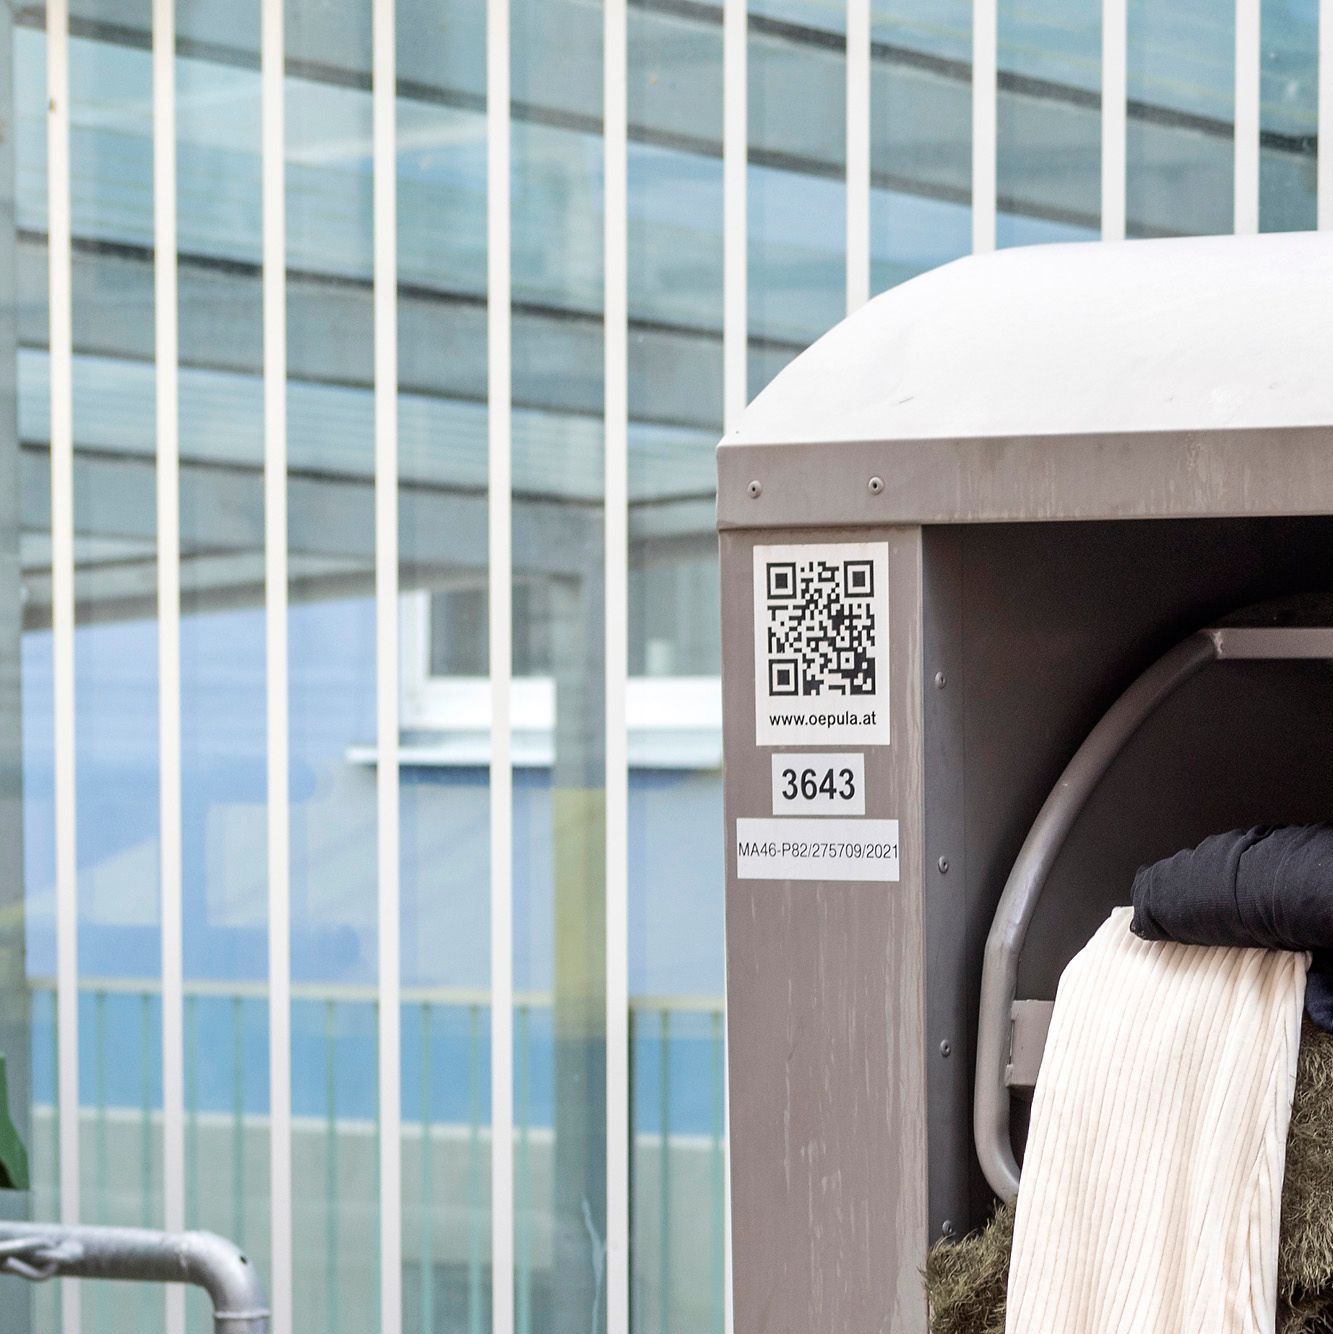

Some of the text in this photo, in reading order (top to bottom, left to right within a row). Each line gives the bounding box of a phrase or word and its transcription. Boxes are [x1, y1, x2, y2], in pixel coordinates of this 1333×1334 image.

[769, 710, 877, 728] www.oepula.at
[781, 768, 856, 801] 3643
[738, 842, 899, 860] MA46-P82/275709/2021
